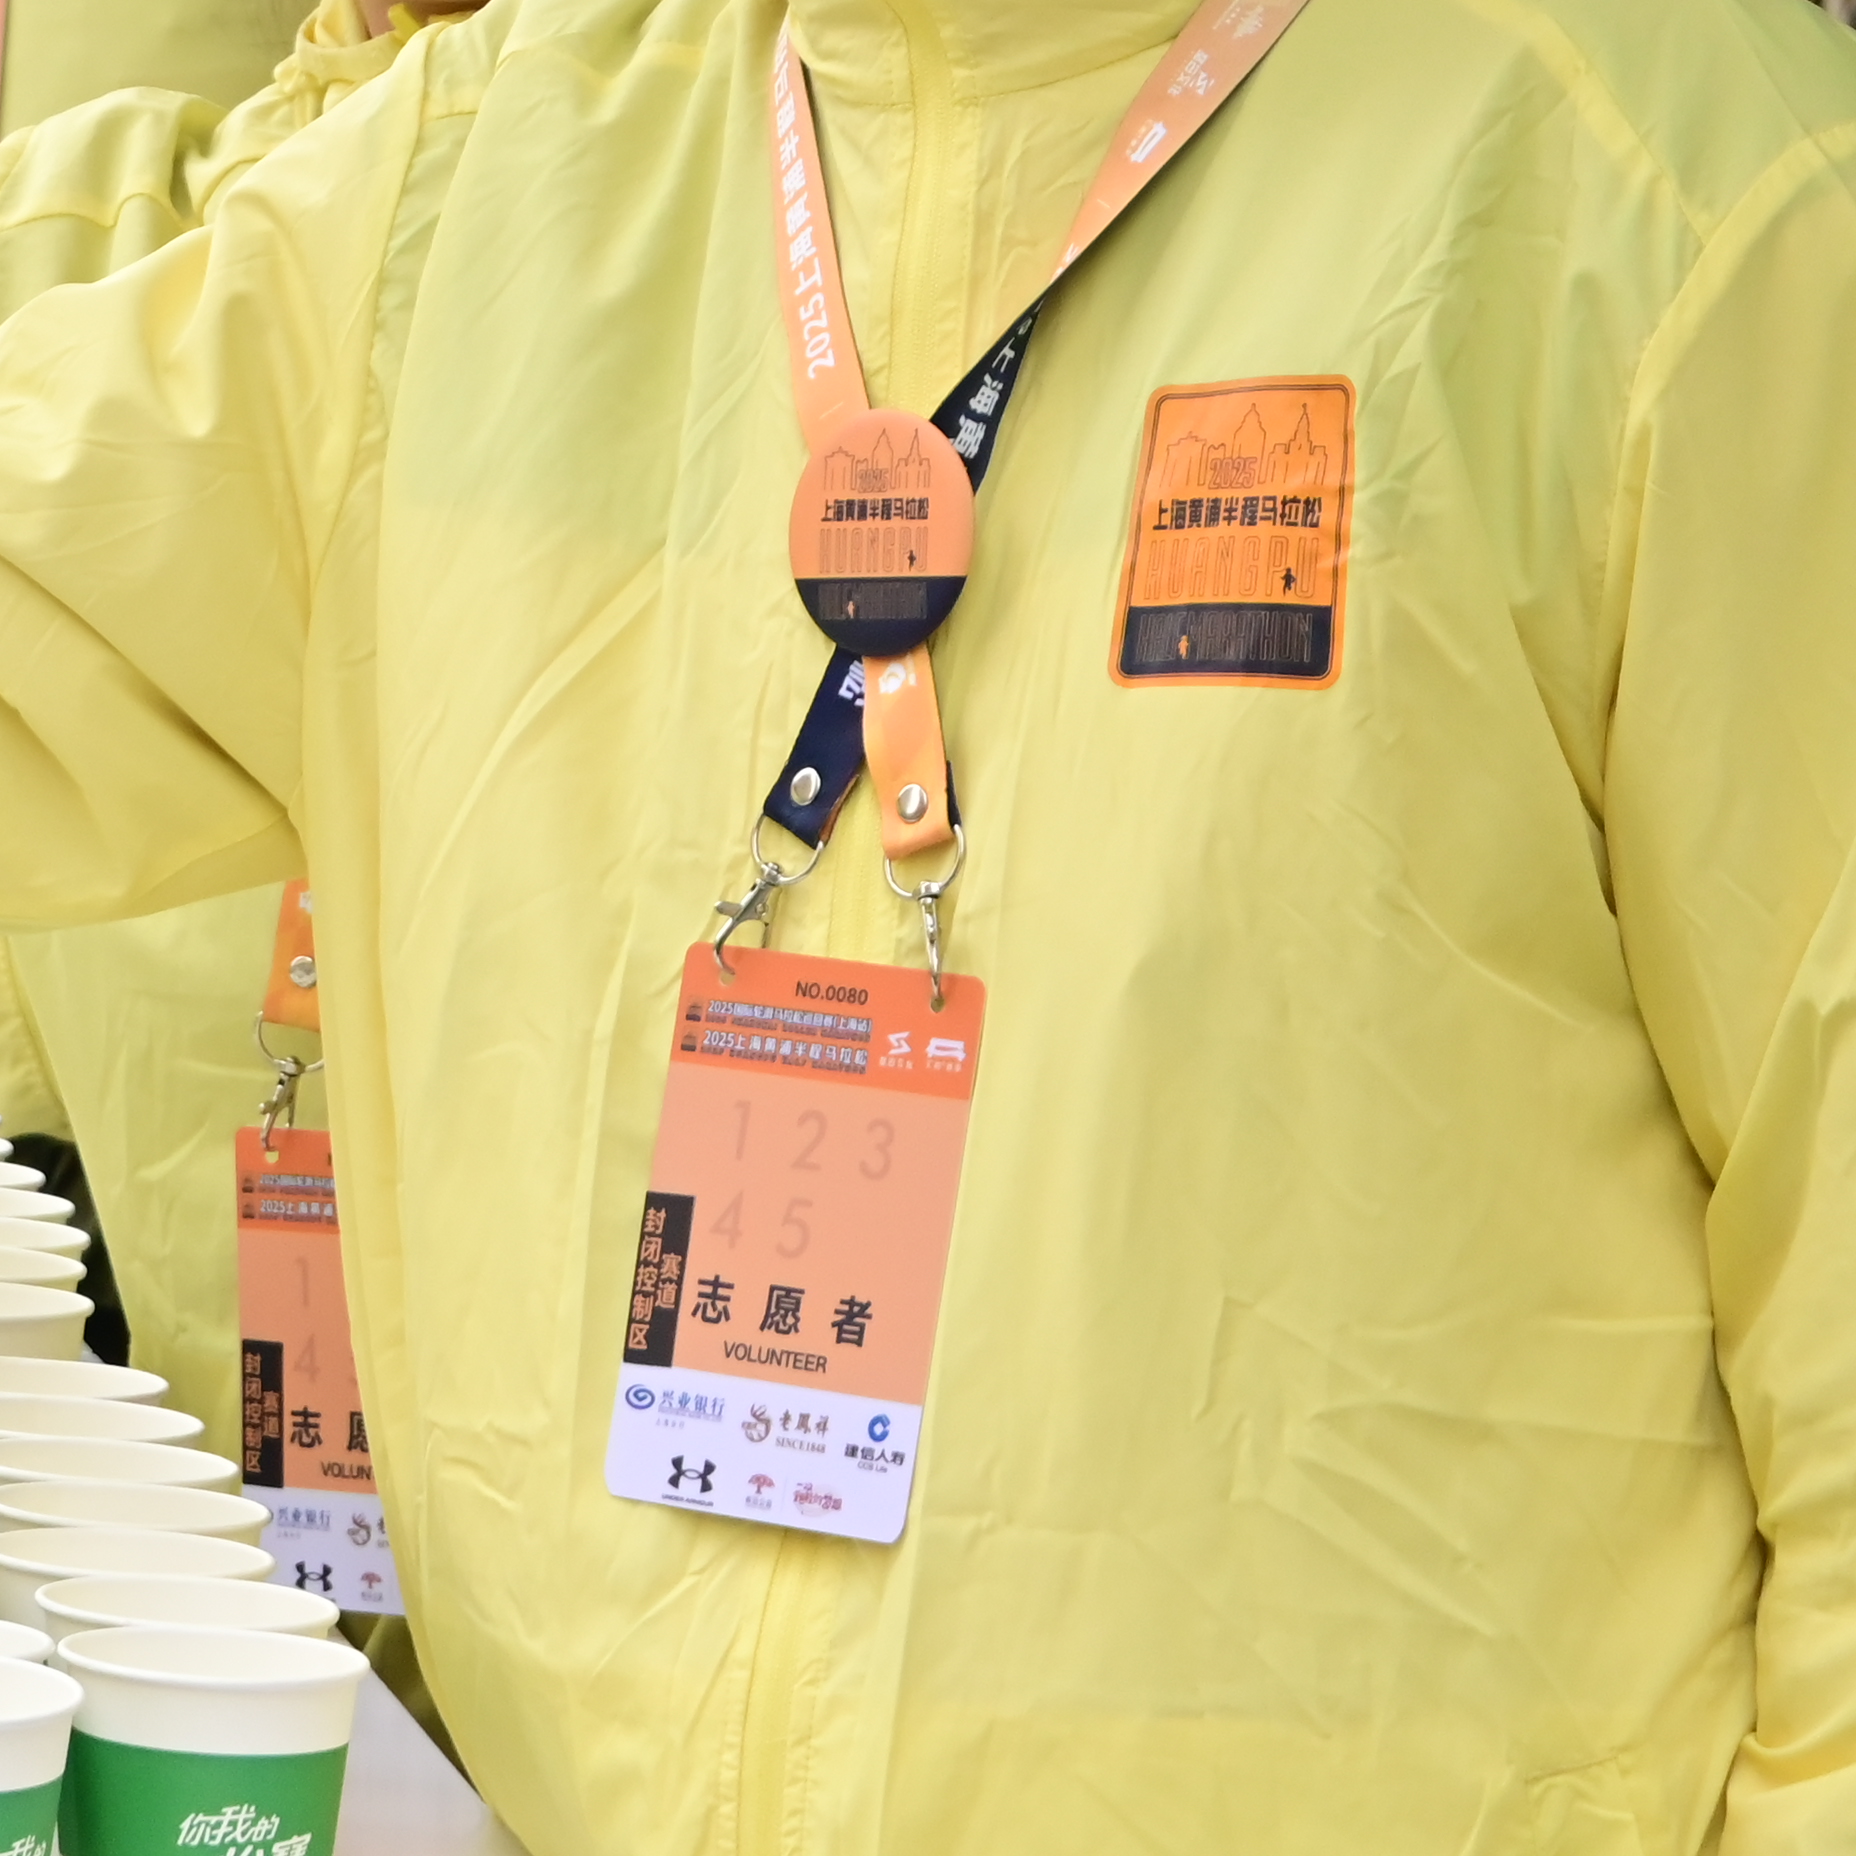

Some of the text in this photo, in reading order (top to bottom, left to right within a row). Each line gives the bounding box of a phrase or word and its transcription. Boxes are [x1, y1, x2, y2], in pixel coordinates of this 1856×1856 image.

[1208, 456, 1258, 490] 2025
[1152, 495, 1323, 531] 上海黄浦半程马拉松
[819, 526, 930, 574] HUANGPU
[1143, 535, 1320, 601] HUANGPU
[795, 980, 868, 1006] NO.0080
[731, 1100, 894, 1181] 1 2 3
[708, 1188, 813, 1260] 4 5
[628, 1206, 667, 1350] 封闭控制区
[654, 1252, 682, 1310] 赛道
[690, 1273, 874, 1348] 志愿者
[723, 1340, 828, 1374] VOLUNTEER
[658, 1389, 725, 1418] 兴业银行
[844, 1443, 906, 1467] 建信人寿
[177, 1803, 281, 1848] 你我的
